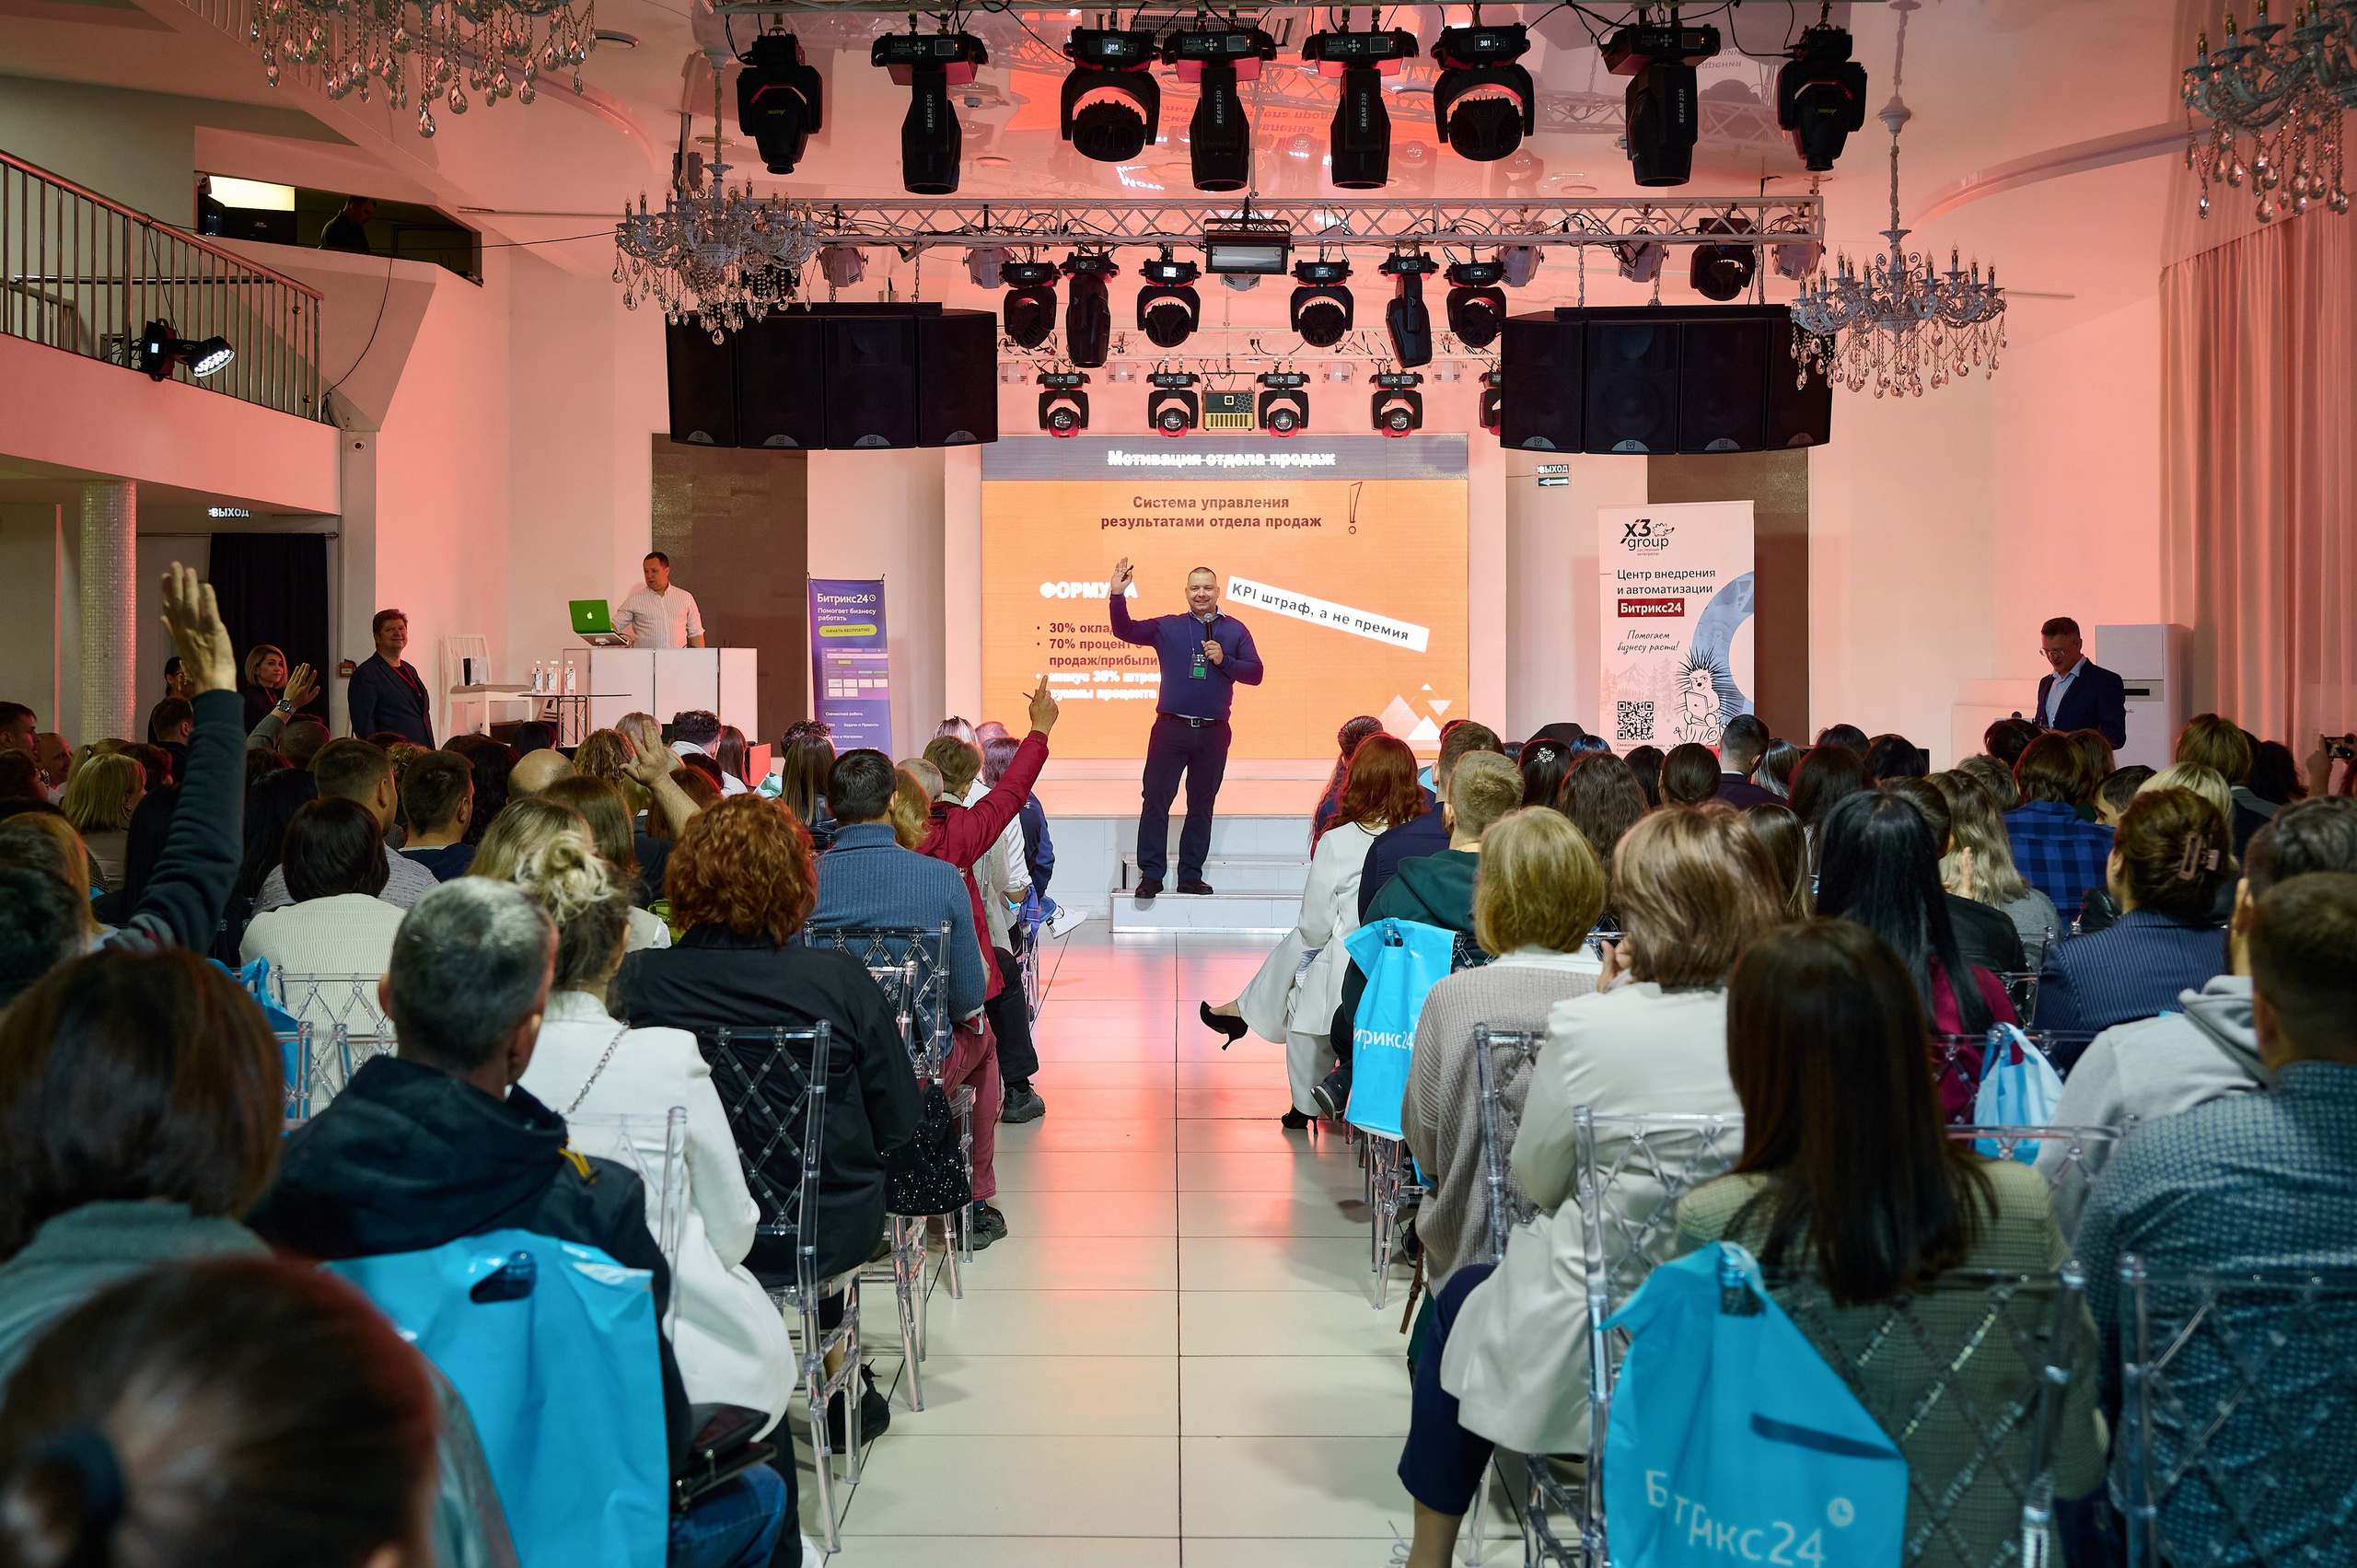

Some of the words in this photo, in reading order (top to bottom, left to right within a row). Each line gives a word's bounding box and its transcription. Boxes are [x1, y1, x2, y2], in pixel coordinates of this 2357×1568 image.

[1107, 450, 1201, 468] Мотивация
[1206, 453, 1265, 468] отдела
[1270, 453, 1336, 469] продаж
[1539, 464, 1568, 474] ВЫХОД
[1132, 495, 1196, 508] Система
[1201, 497, 1289, 511] управления
[211, 507, 250, 517] ВЫХОД
[1101, 517, 1204, 530] результатами
[1209, 517, 1261, 529] отдела
[1265, 517, 1322, 529] продаж
[1627, 538, 1669, 551] group
[1617, 570, 1652, 581] Центр
[1655, 570, 1715, 580] внедрения
[1039, 581, 1138, 598] ФОРМУА
[1626, 586, 1713, 595] автоматизации
[817, 593, 868, 606] Битрикс24
[1232, 583, 1257, 599] KPI
[1261, 594, 1314, 618] штраф,
[1319, 610, 1328, 619] а
[1332, 613, 1350, 624] не
[1354, 619, 1409, 641] премия
[1620, 602, 1682, 615] Битрикс24
[1050, 622, 1075, 633] 30%
[1627, 630, 1670, 639] Помогаем
[1050, 638, 1075, 649] 70%
[1617, 642, 1647, 655] бизнесу
[1649, 641, 1680, 653] расти!
[1050, 655, 1158, 668] продаж/прибыли
[1353, 1028, 1414, 1051] итрикс24
